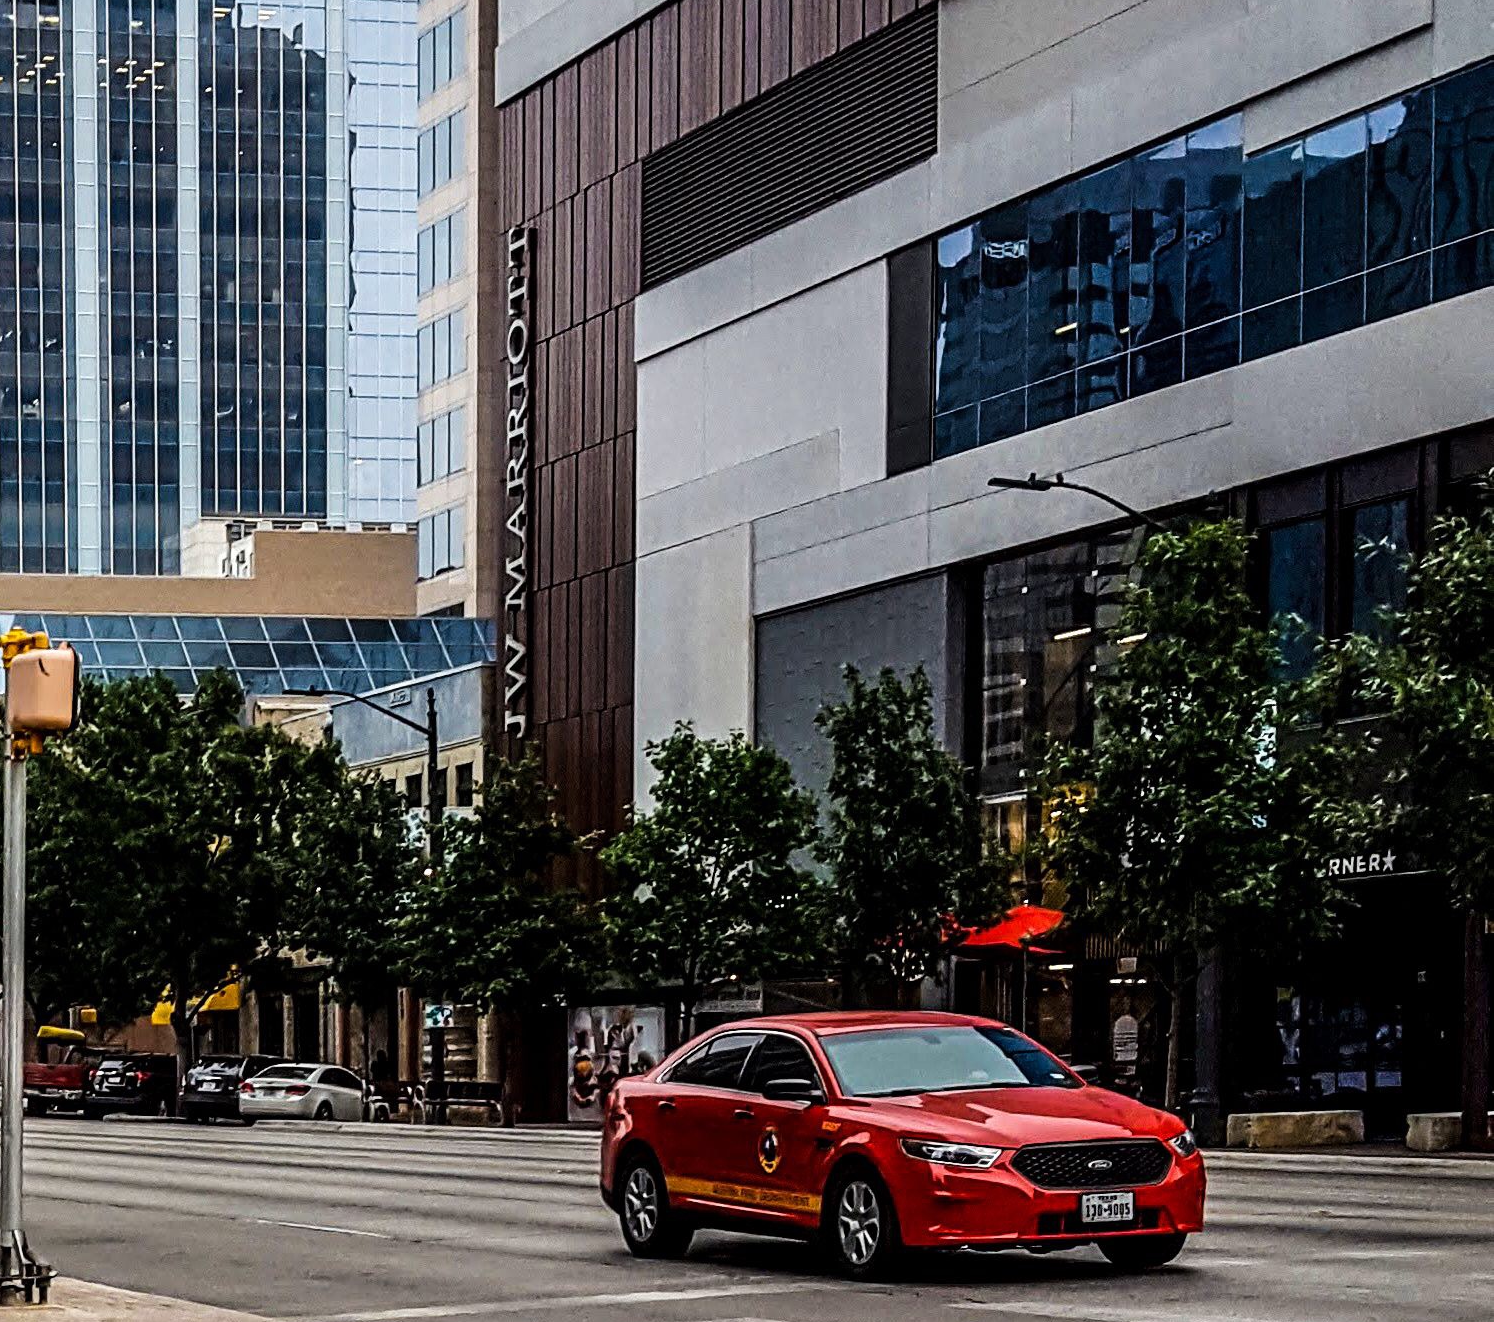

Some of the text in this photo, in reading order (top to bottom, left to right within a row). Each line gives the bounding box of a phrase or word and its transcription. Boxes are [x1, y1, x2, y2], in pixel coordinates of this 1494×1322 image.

[504, 226, 528, 740] JW MARRIOTT
[1328, 853, 1381, 876] RNER
